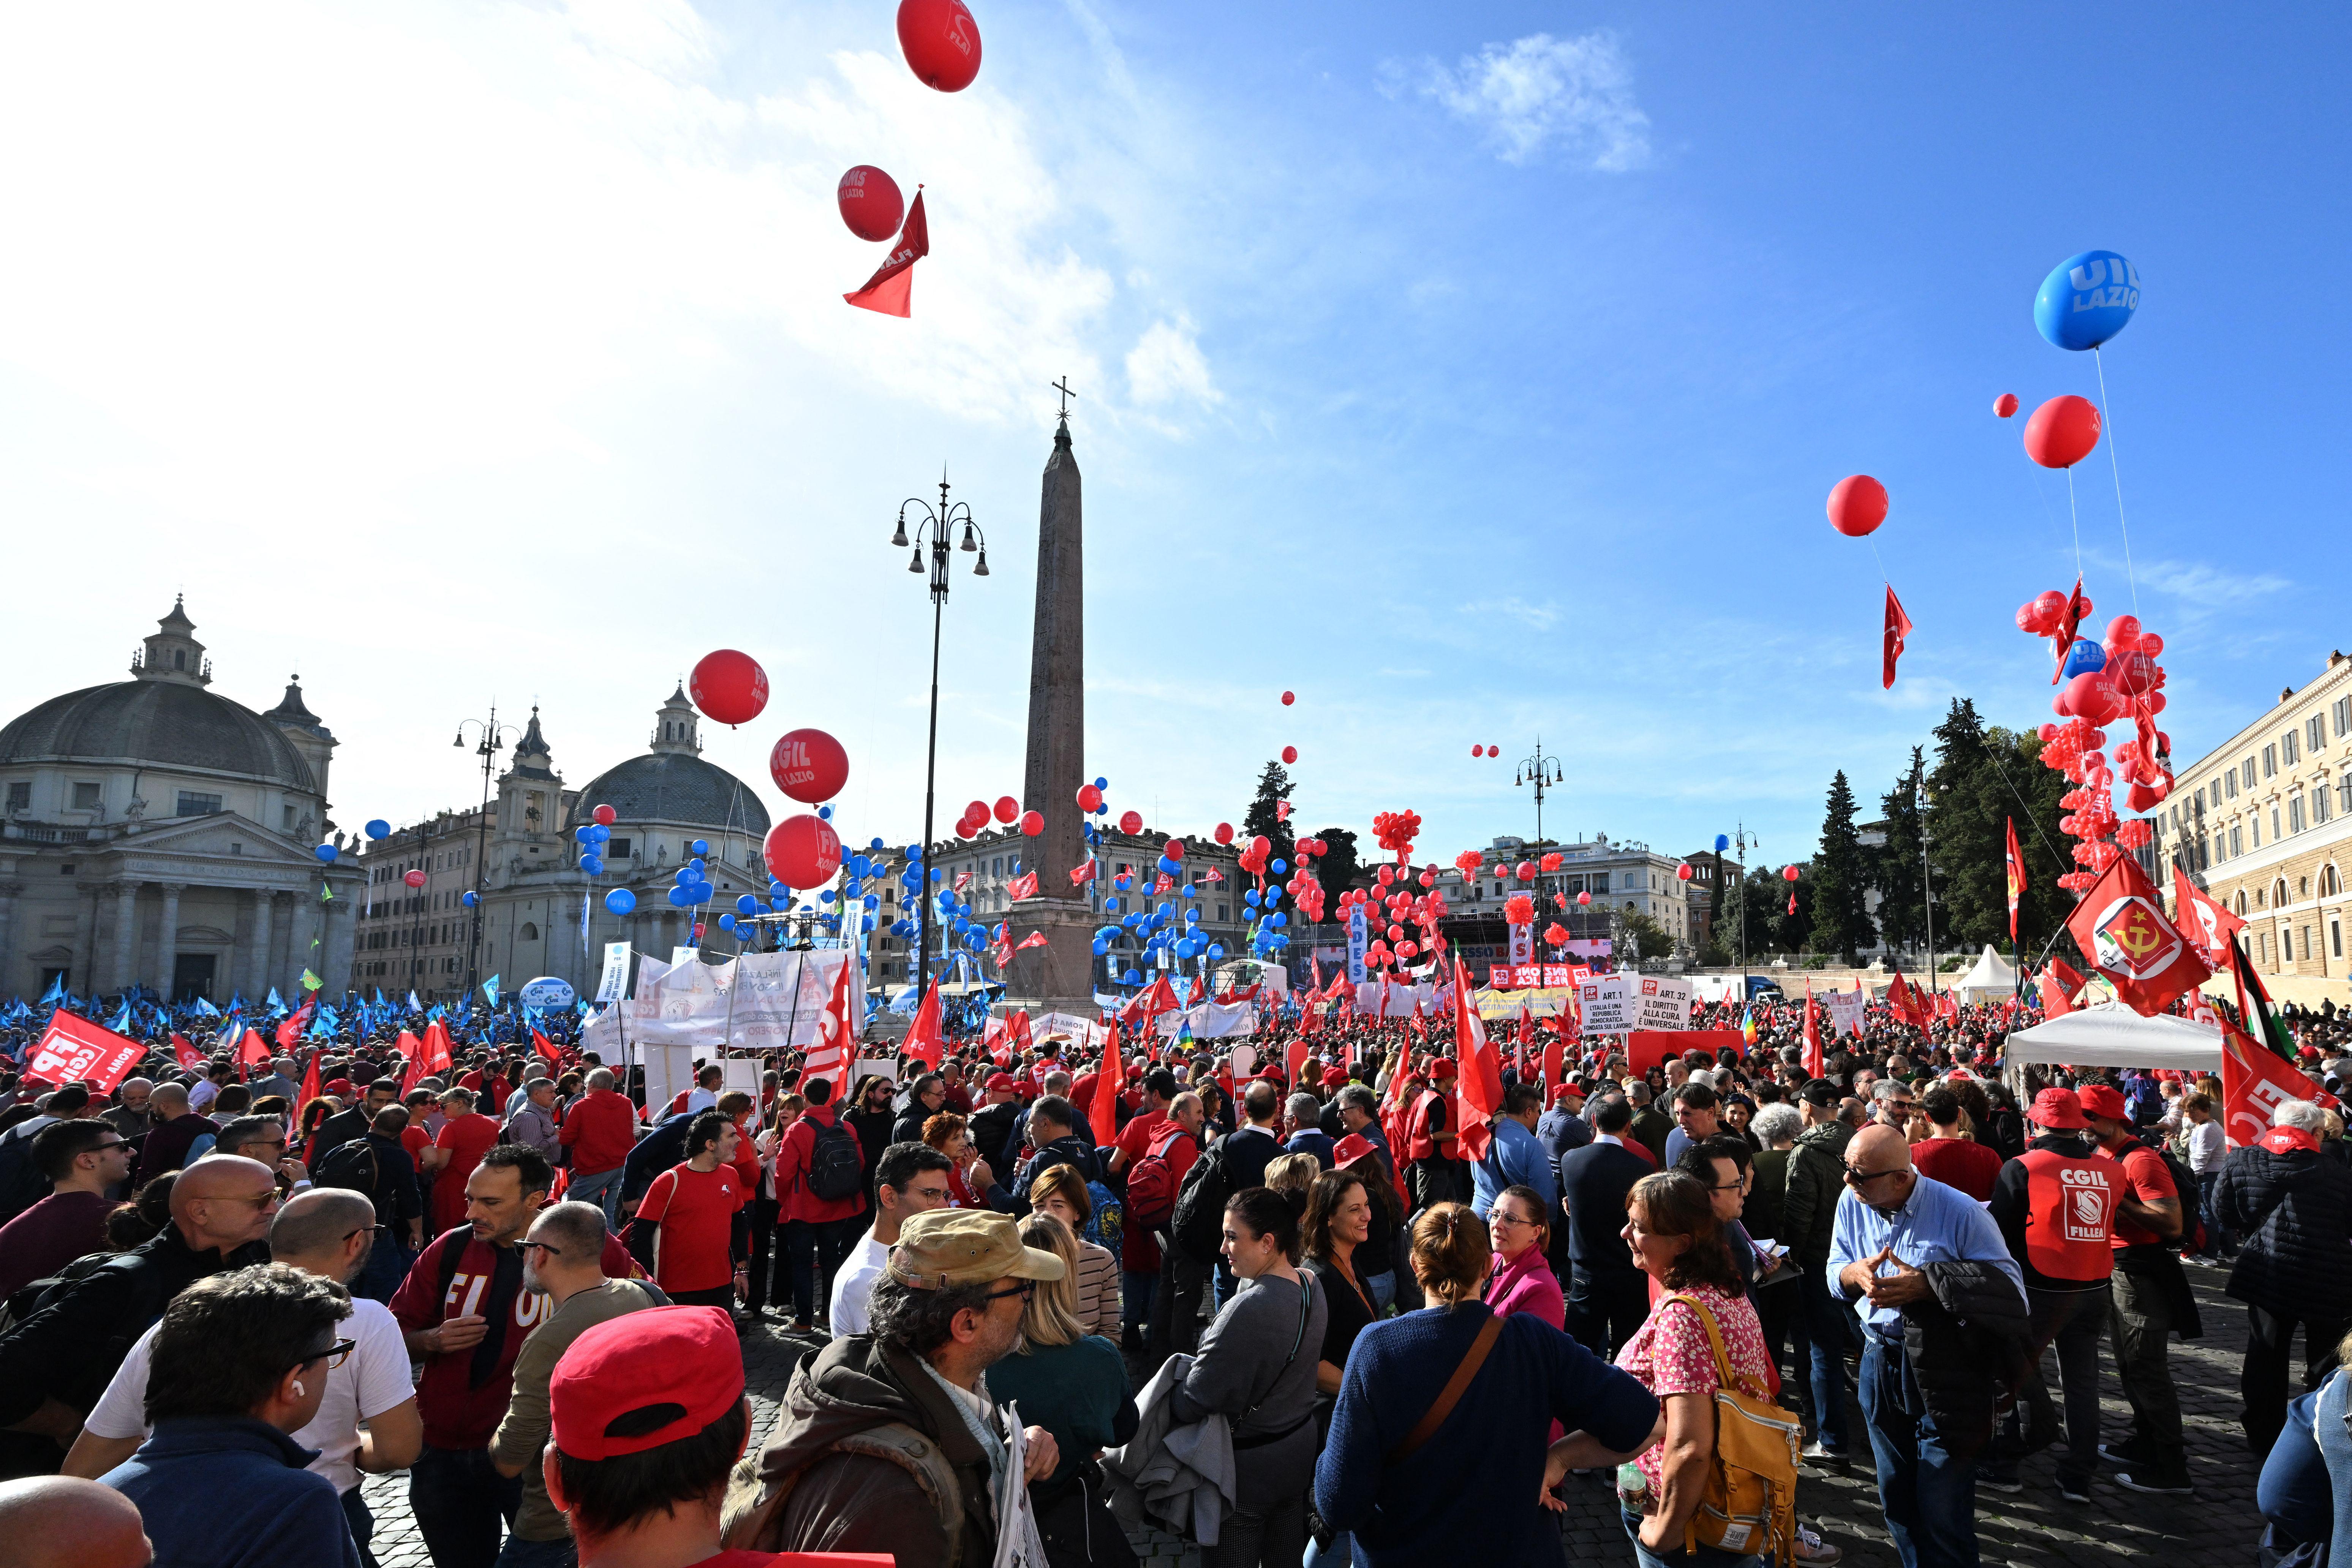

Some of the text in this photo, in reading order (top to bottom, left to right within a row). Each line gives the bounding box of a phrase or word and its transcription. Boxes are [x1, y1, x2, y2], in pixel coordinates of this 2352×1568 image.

[949, 31, 971, 56] FLAI
[846, 188, 864, 199] LAZIO
[2069, 258, 2141, 291] UIL
[2073, 286, 2139, 313] LAZIO
[2075, 644, 2105, 655] UIL
[2076, 653, 2106, 664] LAZIO
[2096, 682, 2109, 692] SLC
[785, 770, 815, 786] LAZIO
[820, 830, 838, 855] FP
[609, 898, 628, 908] UIL
[2101, 950, 2118, 968] PCI
[604, 980, 613, 997] SPICCIOLI
[1603, 992, 1617, 1000] ART.
[1660, 989, 1686, 1001] ART. 32
[1652, 1001, 1679, 1011] DIRITTO
[1643, 1009, 1680, 1021] ALLA CURA
[1638, 1016, 1685, 1031] È UNIVERSALE
[2060, 1169, 2109, 1186] CGIL
[2071, 1226, 2104, 1238] FILLEA
